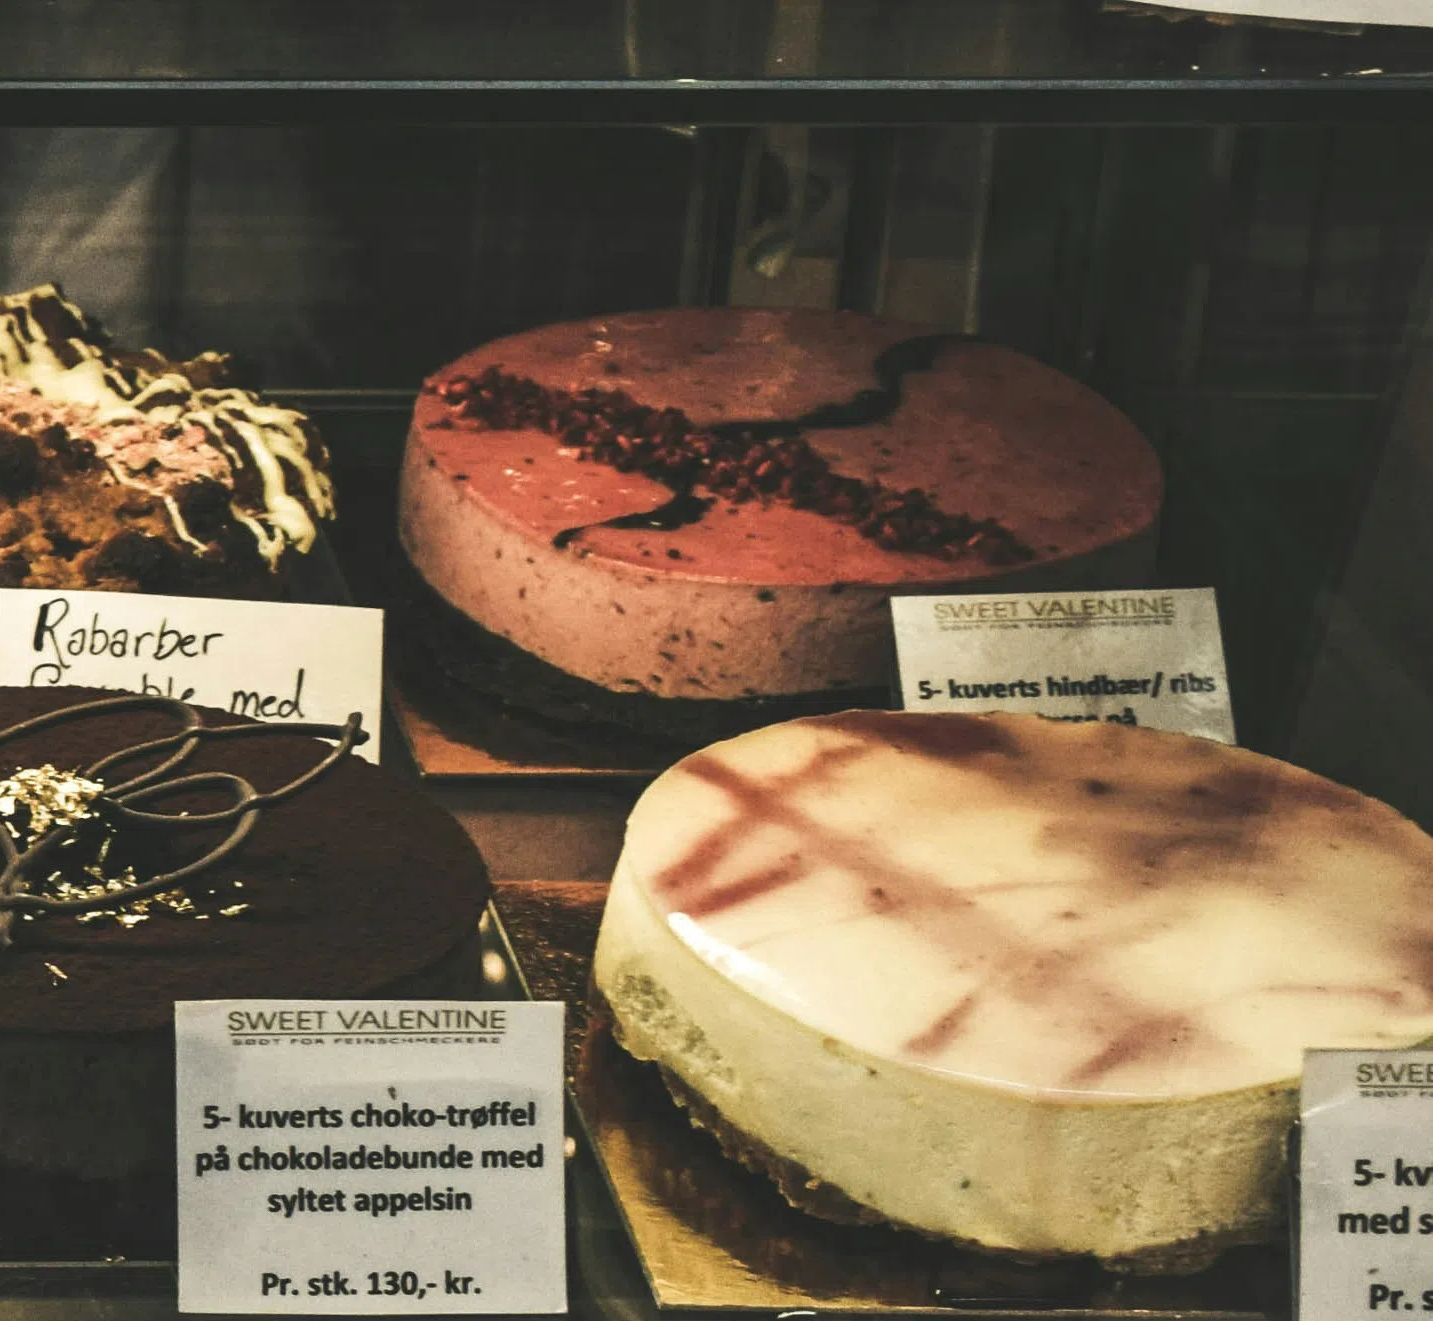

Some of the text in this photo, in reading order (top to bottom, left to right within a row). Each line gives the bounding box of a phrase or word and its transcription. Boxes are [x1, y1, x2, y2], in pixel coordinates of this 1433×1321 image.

[933, 596, 1175, 619] SWEET VALENTINE
[33, 598, 224, 669] Rabarber
[230, 668, 305, 718] med
[949, 677, 1041, 700] kuverts
[1170, 674, 1216, 694] ribs
[228, 1010, 506, 1031] SWEET VALENTINE
[203, 1102, 536, 1129] 5- kuverts choko-trøffel
[195, 1144, 543, 1177] på chokoladebunde med
[1354, 1159, 1385, 1187] 5-
[267, 1187, 472, 1218] syltet appelsin
[1338, 1206, 1409, 1234] med
[261, 1271, 482, 1300] Pr. stk. 130,- kr.
[1369, 1284, 1413, 1311] Pr.
